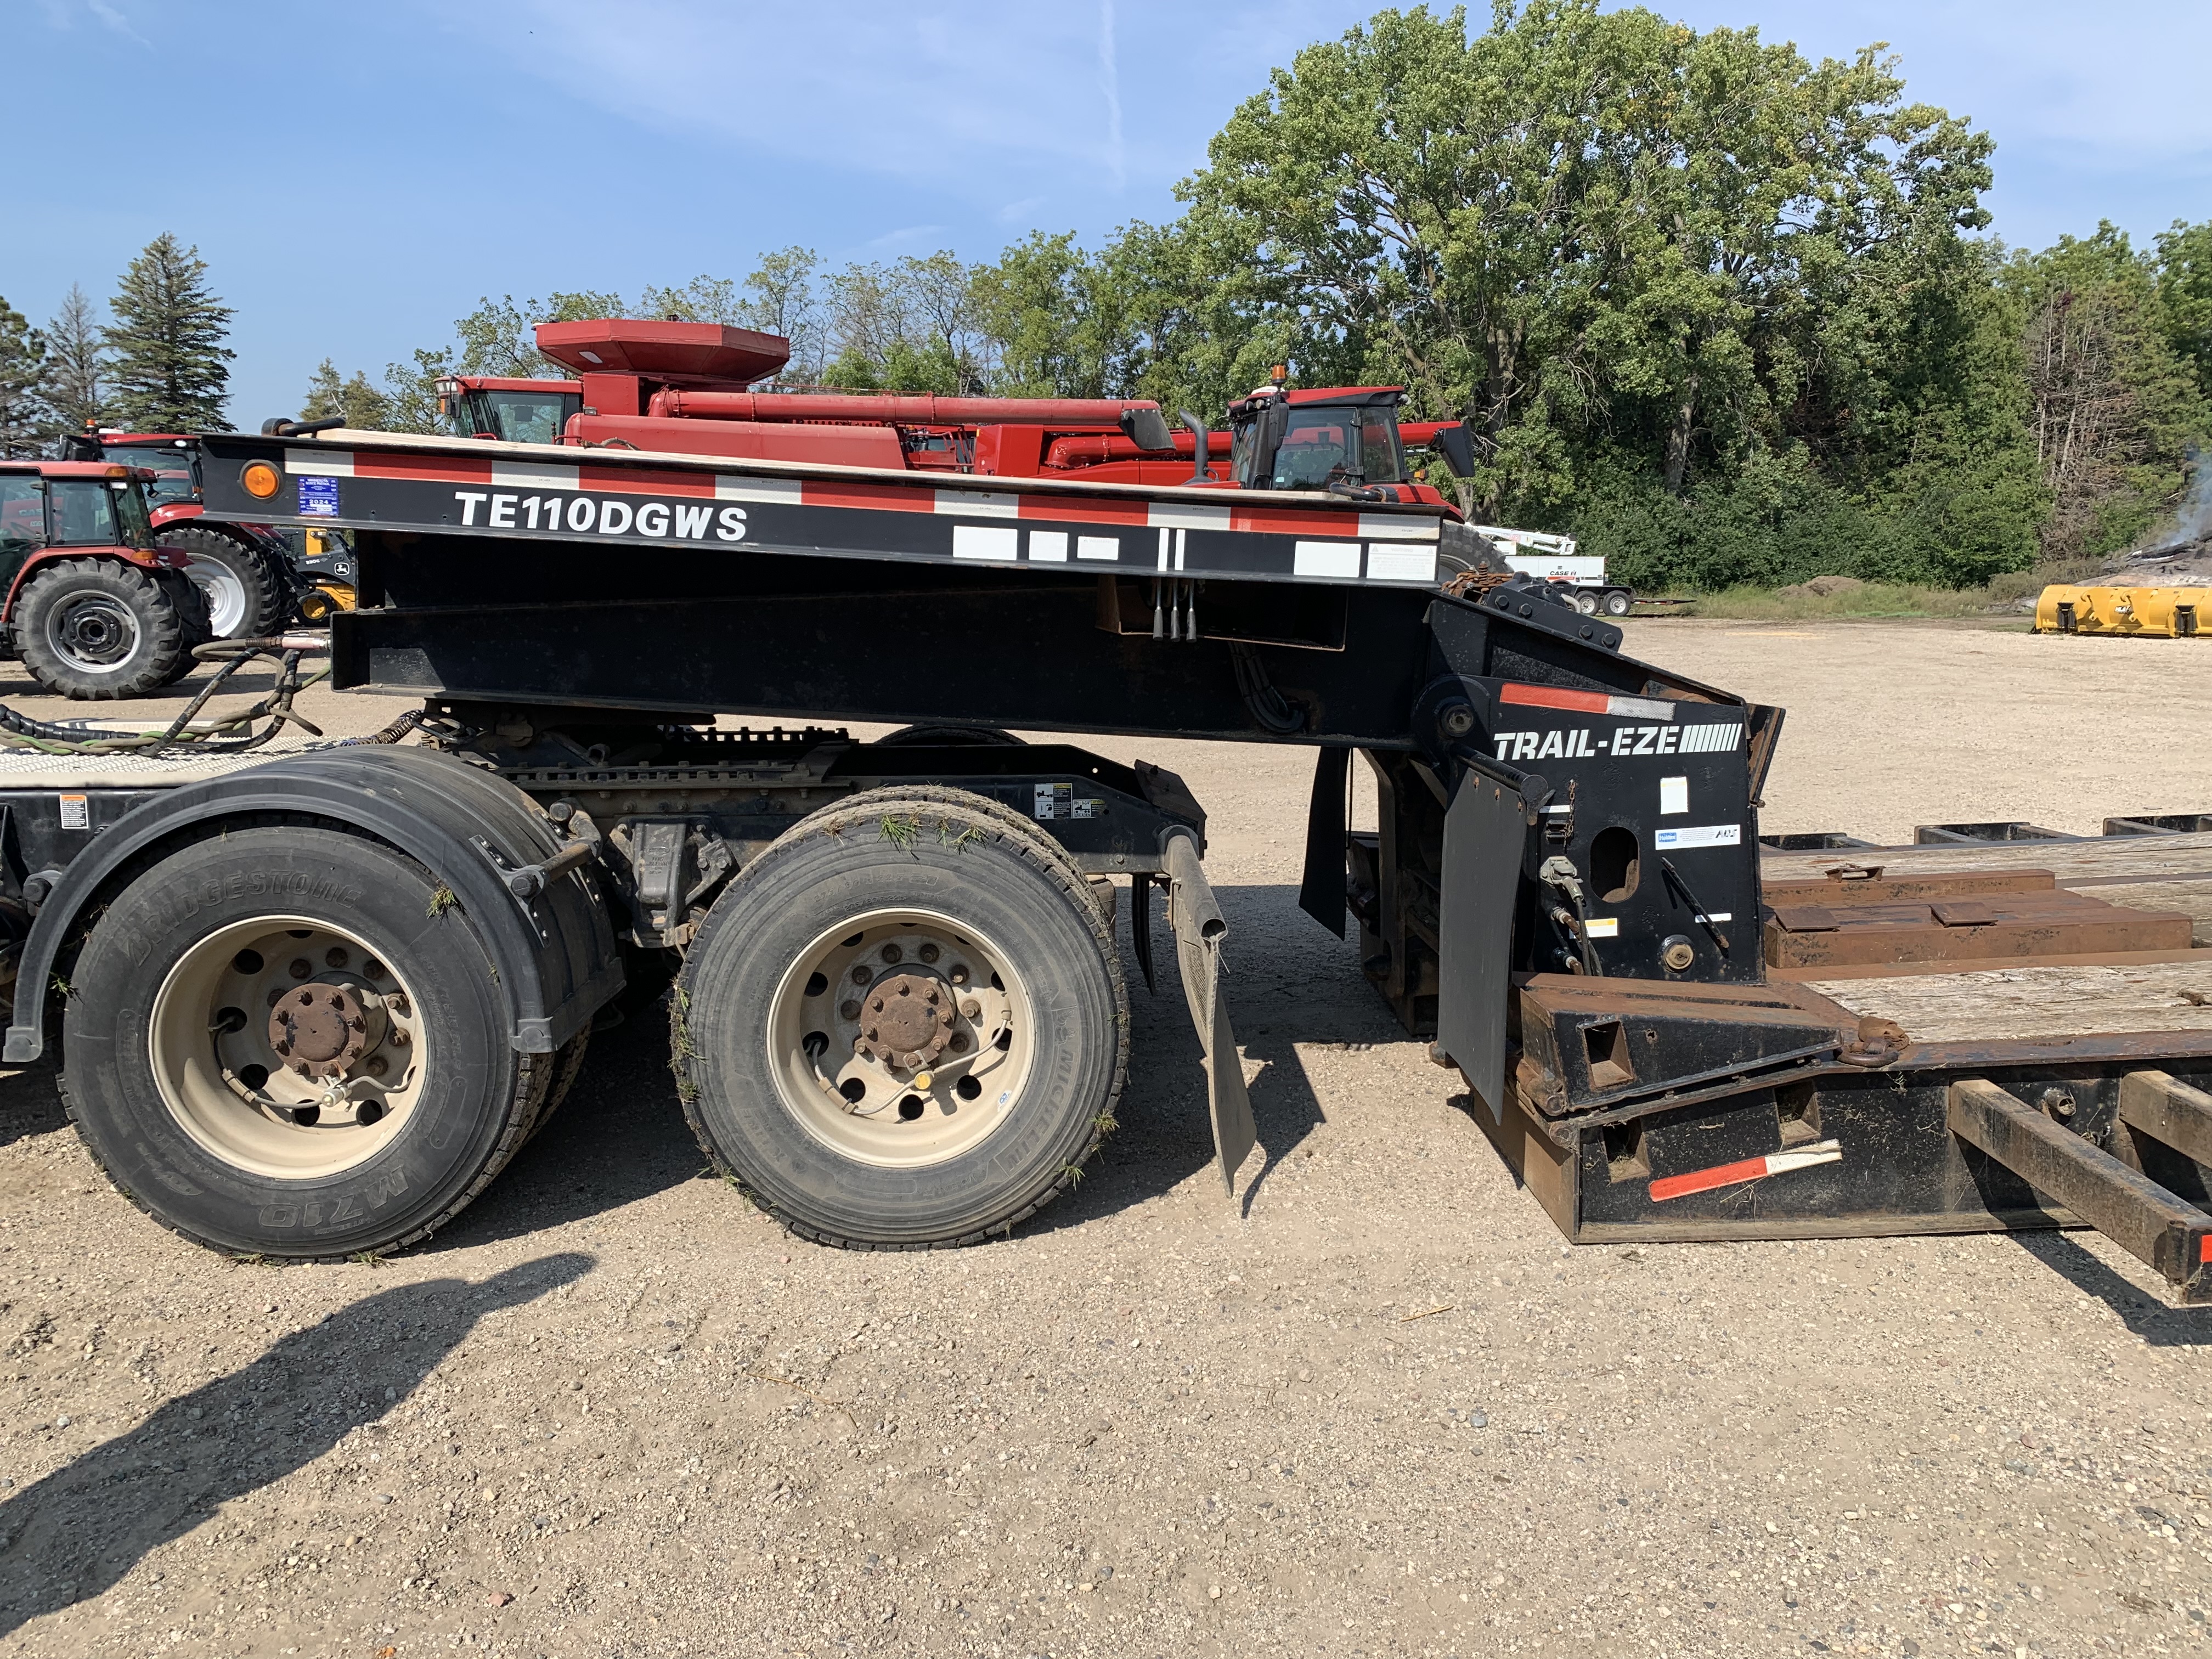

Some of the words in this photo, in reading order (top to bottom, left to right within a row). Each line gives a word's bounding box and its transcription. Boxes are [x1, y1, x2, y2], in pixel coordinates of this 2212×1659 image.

[454, 492, 748, 541] TE110DGWS
[1493, 726, 1680, 761] TRAIL-EZE
[123, 870, 365, 968] BRIDGESTONE
[1006, 1049, 1075, 1172] MICHELIN
[258, 1165, 410, 1228] M710
